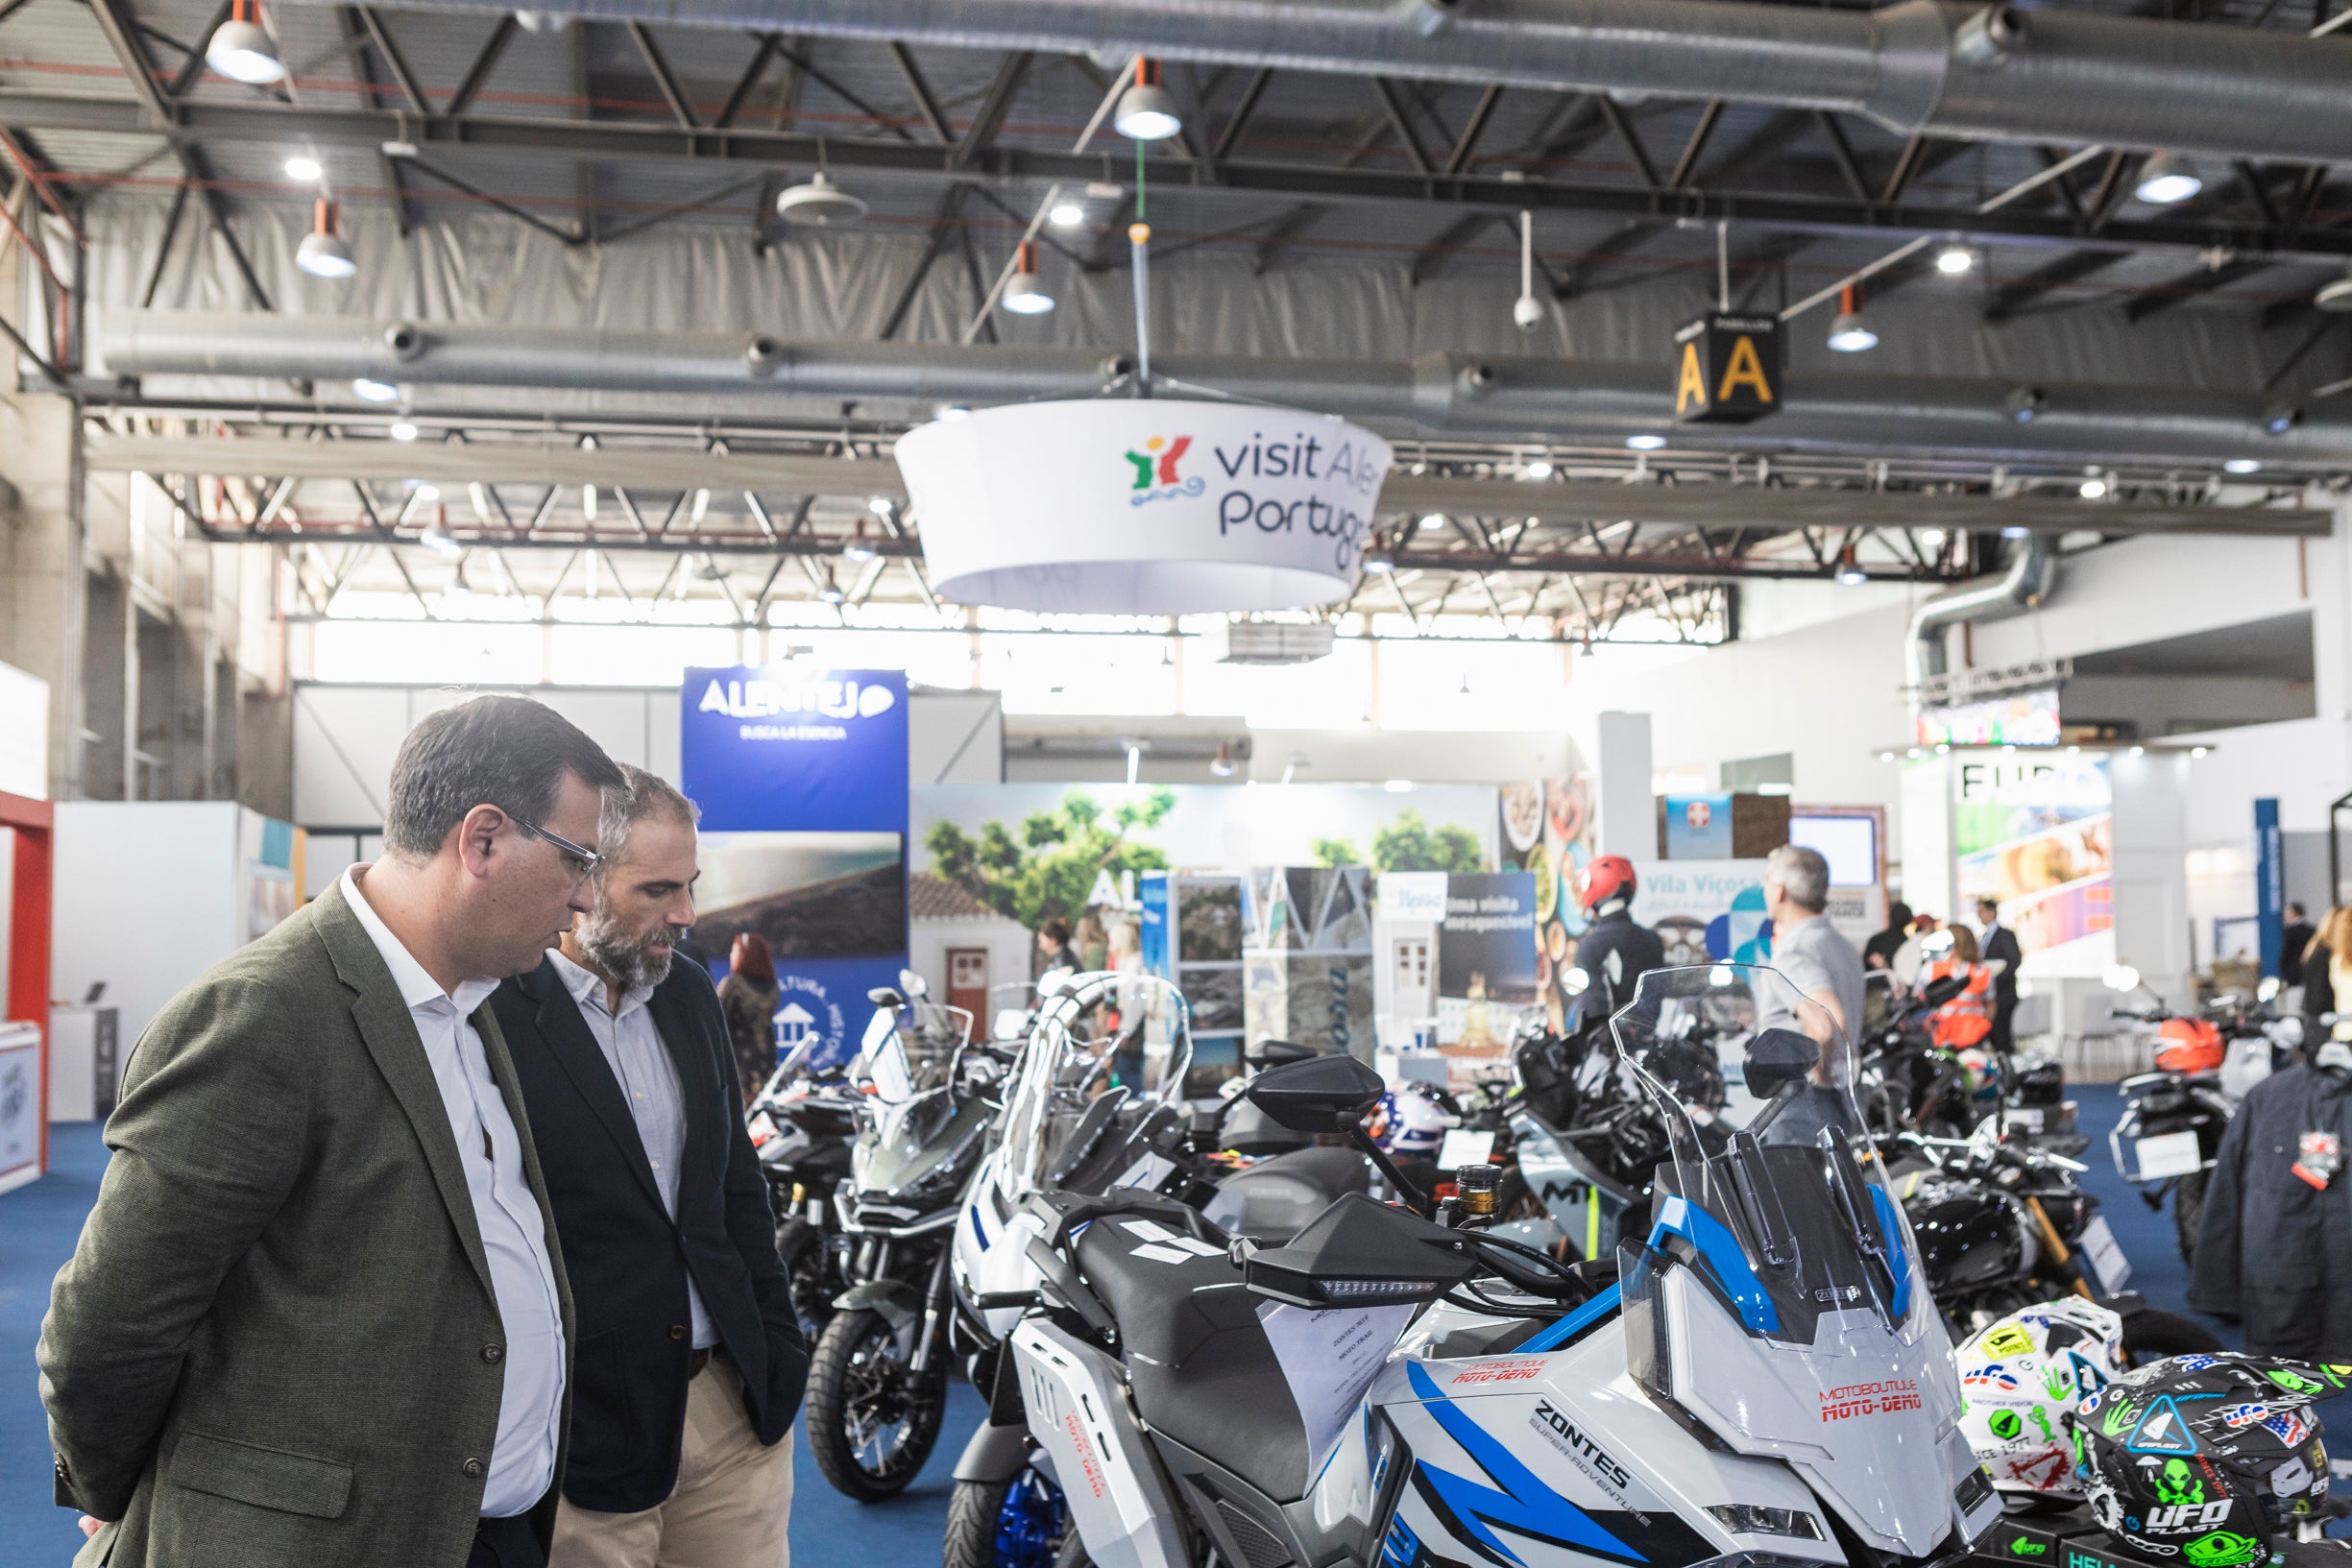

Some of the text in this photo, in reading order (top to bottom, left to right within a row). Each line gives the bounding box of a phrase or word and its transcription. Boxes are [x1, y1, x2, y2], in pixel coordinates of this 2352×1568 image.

[1676, 342, 1706, 413] A
[1718, 335, 1773, 403] A
[1215, 432, 1321, 478] visit
[1220, 491, 1364, 570] Portug
[1646, 874, 1686, 893] Vila
[1451, 1368, 1541, 1384] MOTO-DEMO
[1819, 1379, 1918, 1402] MOTOBOUTIQUE
[1822, 1393, 1922, 1423] MOTO-DEMO
[1535, 1399, 1632, 1489] ZONTES
[1528, 1416, 1653, 1528] SUPER-ADVENTURE
[2145, 1498, 2234, 1528] UFO
[2145, 1522, 2225, 1534] PLAST
